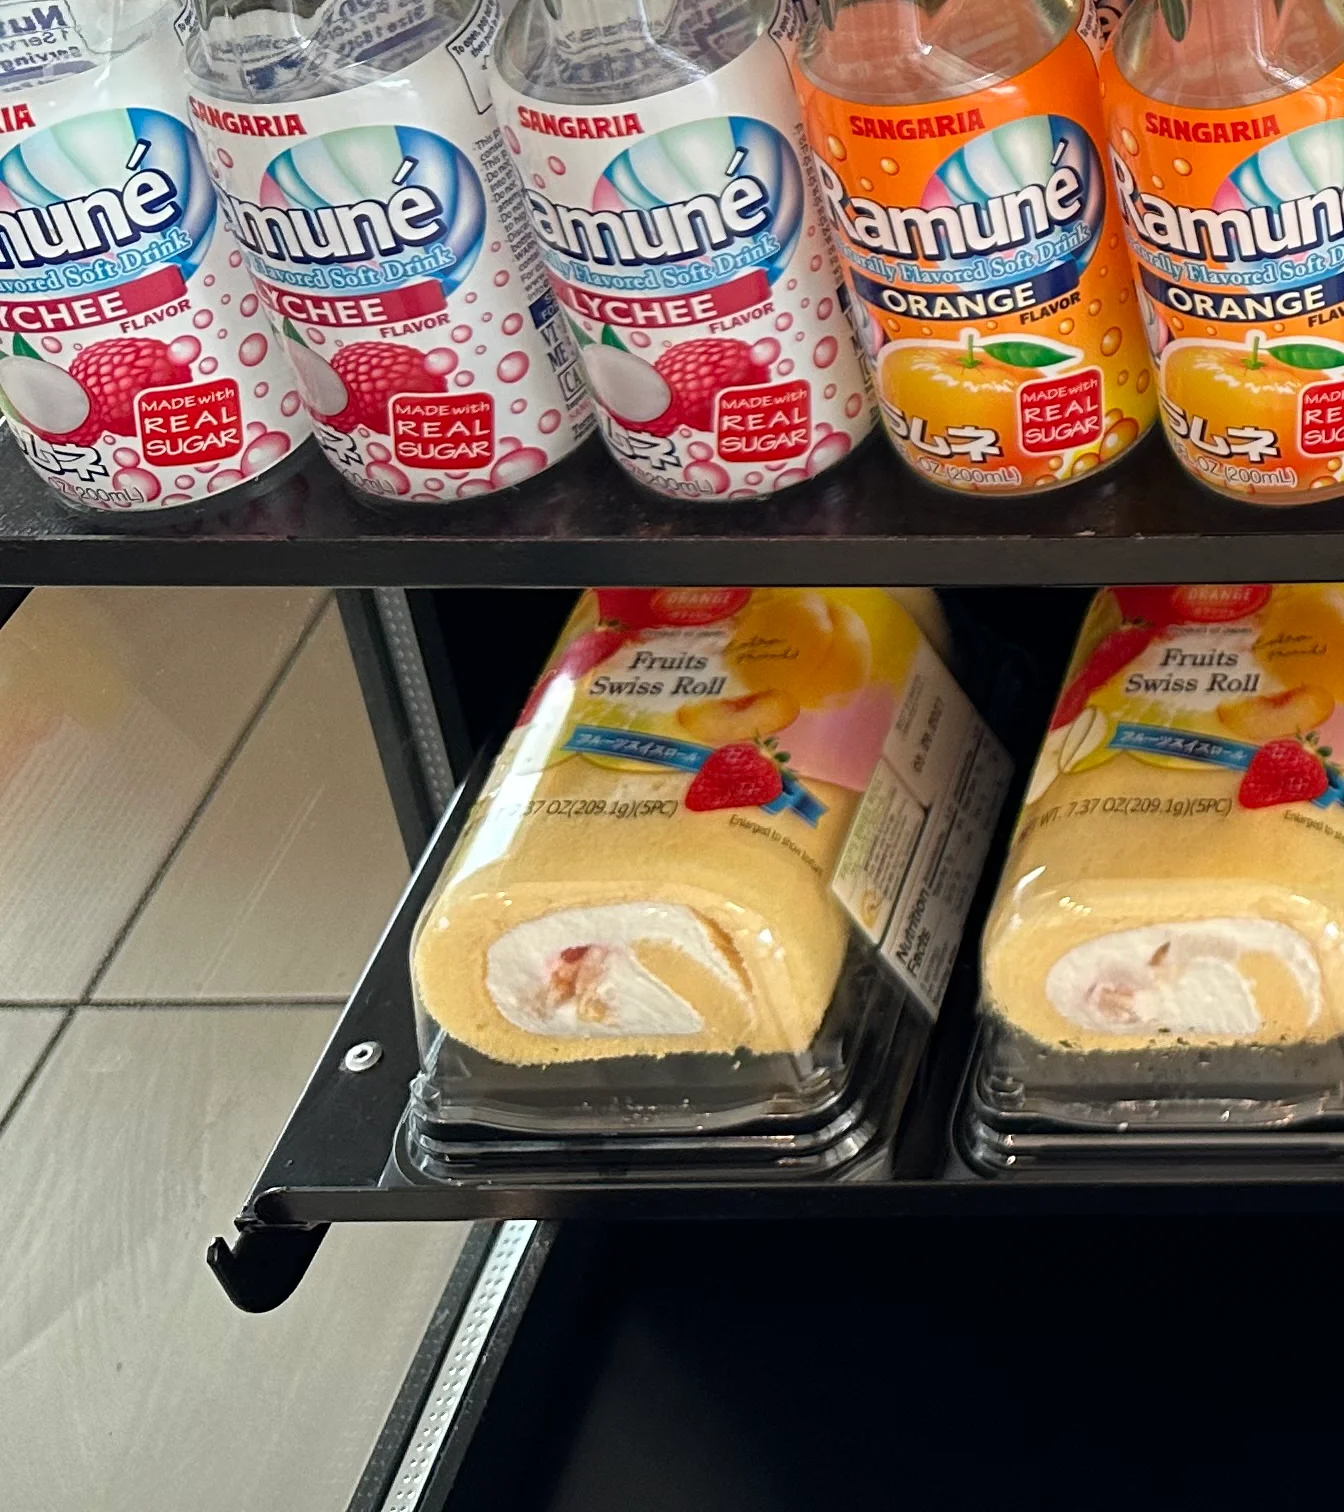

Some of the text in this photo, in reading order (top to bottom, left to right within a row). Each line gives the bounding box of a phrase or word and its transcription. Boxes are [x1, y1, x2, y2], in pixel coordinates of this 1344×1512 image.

[188, 95, 308, 138] SANGARIA
[517, 105, 645, 140] SANGARIA
[849, 108, 986, 141] SANGARIA
[814, 138, 1085, 260] Ramuné
[663, 264, 713, 289] Soft
[714, 236, 781, 281] Drink
[566, 292, 719, 328] LYCHEE
[881, 281, 1037, 321] ORANGE
[1168, 285, 1327, 322] ORANGE
[140, 387, 236, 415] MADE with
[144, 406, 239, 434] REAL
[145, 427, 241, 457] SUGAR
[628, 651, 709, 670] Fruits
[1159, 647, 1239, 668] Fruits
[589, 675, 728, 696] Swiss Roll
[1124, 673, 1260, 693] Swiss Roll
